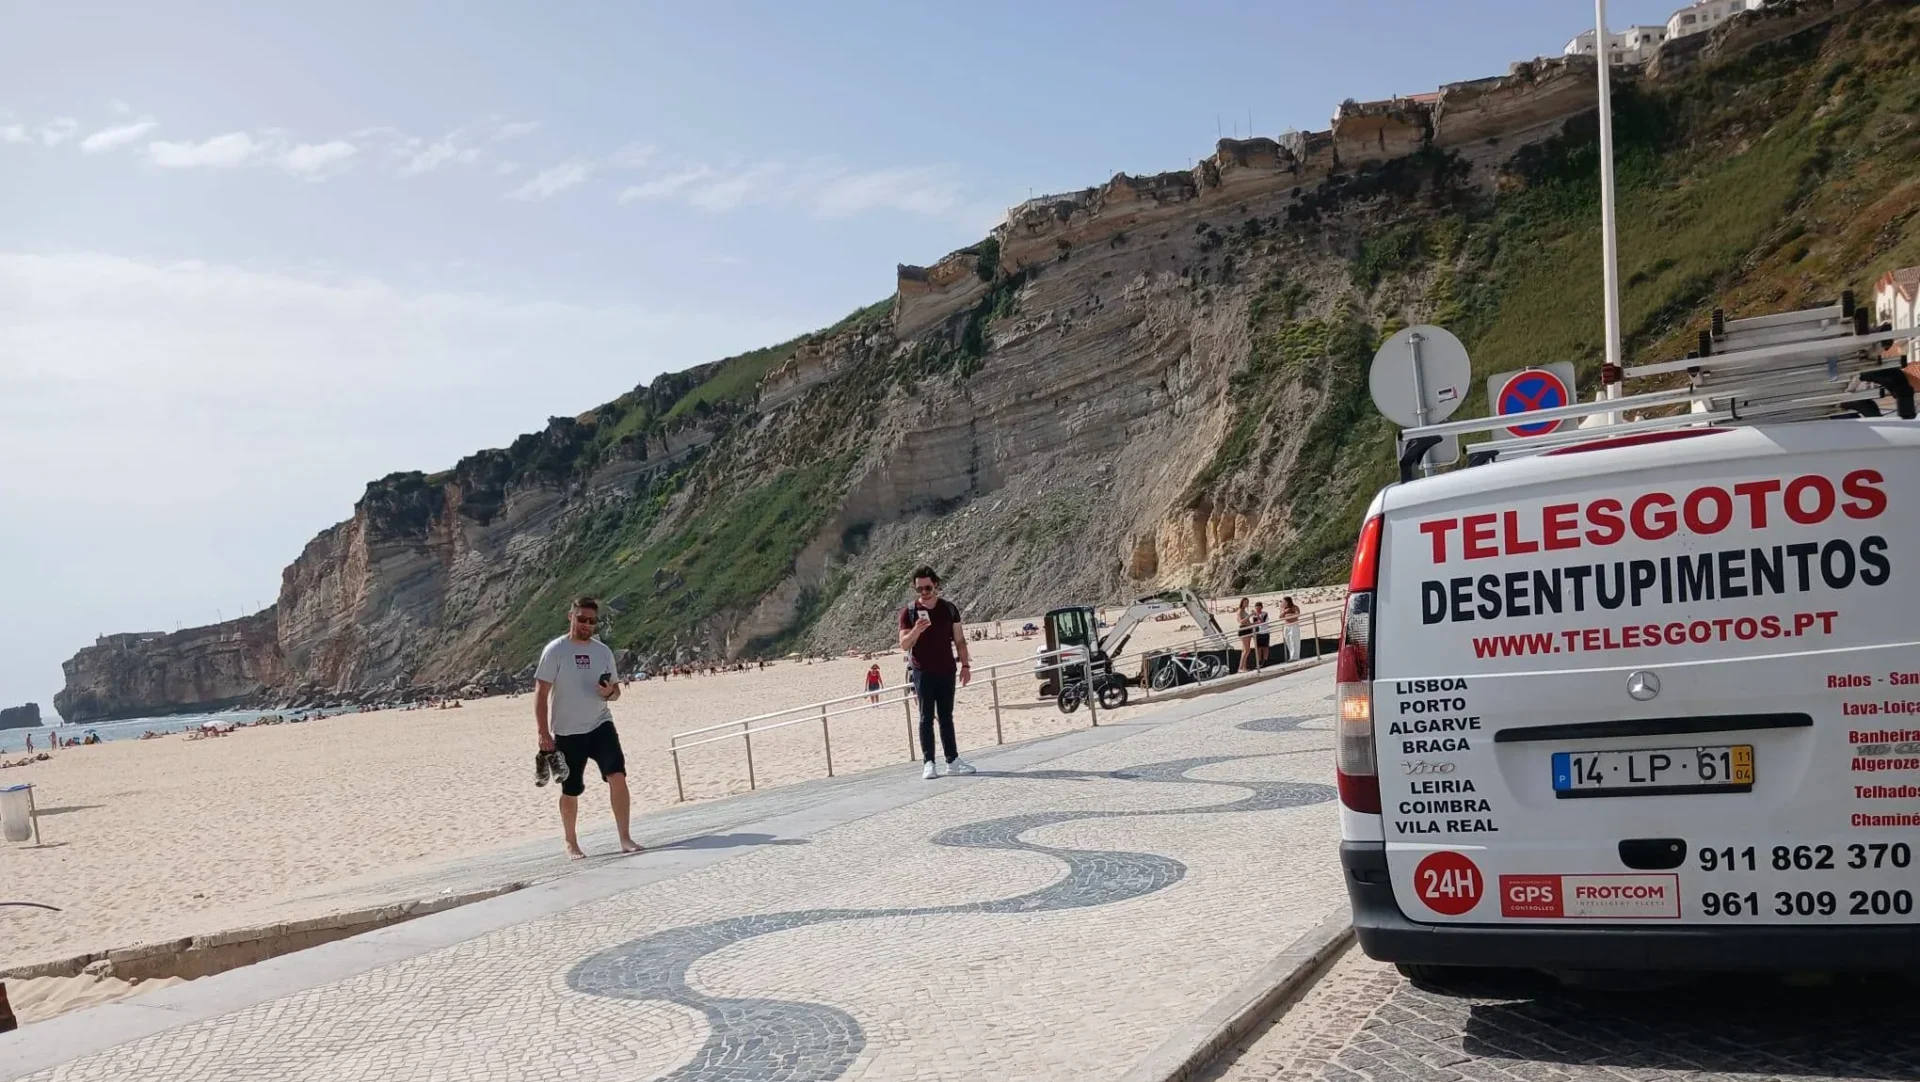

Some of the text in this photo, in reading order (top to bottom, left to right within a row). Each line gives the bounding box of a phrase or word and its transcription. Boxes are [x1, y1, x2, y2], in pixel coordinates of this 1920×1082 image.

[1420, 469, 1887, 564] TELESGOTOS
[1421, 535, 1891, 625] DESENTUPIMENTOS
[1472, 611, 1839, 659] WWW.TELESGOTOS.PT
[1396, 678, 1468, 695] LISBOA
[1827, 674, 1872, 689] Ralos
[1889, 671, 1920, 686] San
[1400, 697, 1466, 714] PORTO
[1389, 716, 1482, 735] ALGARVE
[1402, 737, 1471, 754] BRAGA
[1738, 751, 1751, 762] 11
[1558, 775, 1566, 783] P
[1736, 769, 1751, 780] 04
[1410, 779, 1476, 794] LEIRIA
[1399, 799, 1492, 814] COIMBRA
[1395, 819, 1499, 834] VILA REAL
[1699, 842, 1911, 871] 911 862 370
[1423, 868, 1475, 898] 24H
[1510, 886, 1553, 902] GPS
[1576, 886, 1664, 899] FROTCOM
[1702, 890, 1913, 916] 961 309 200
